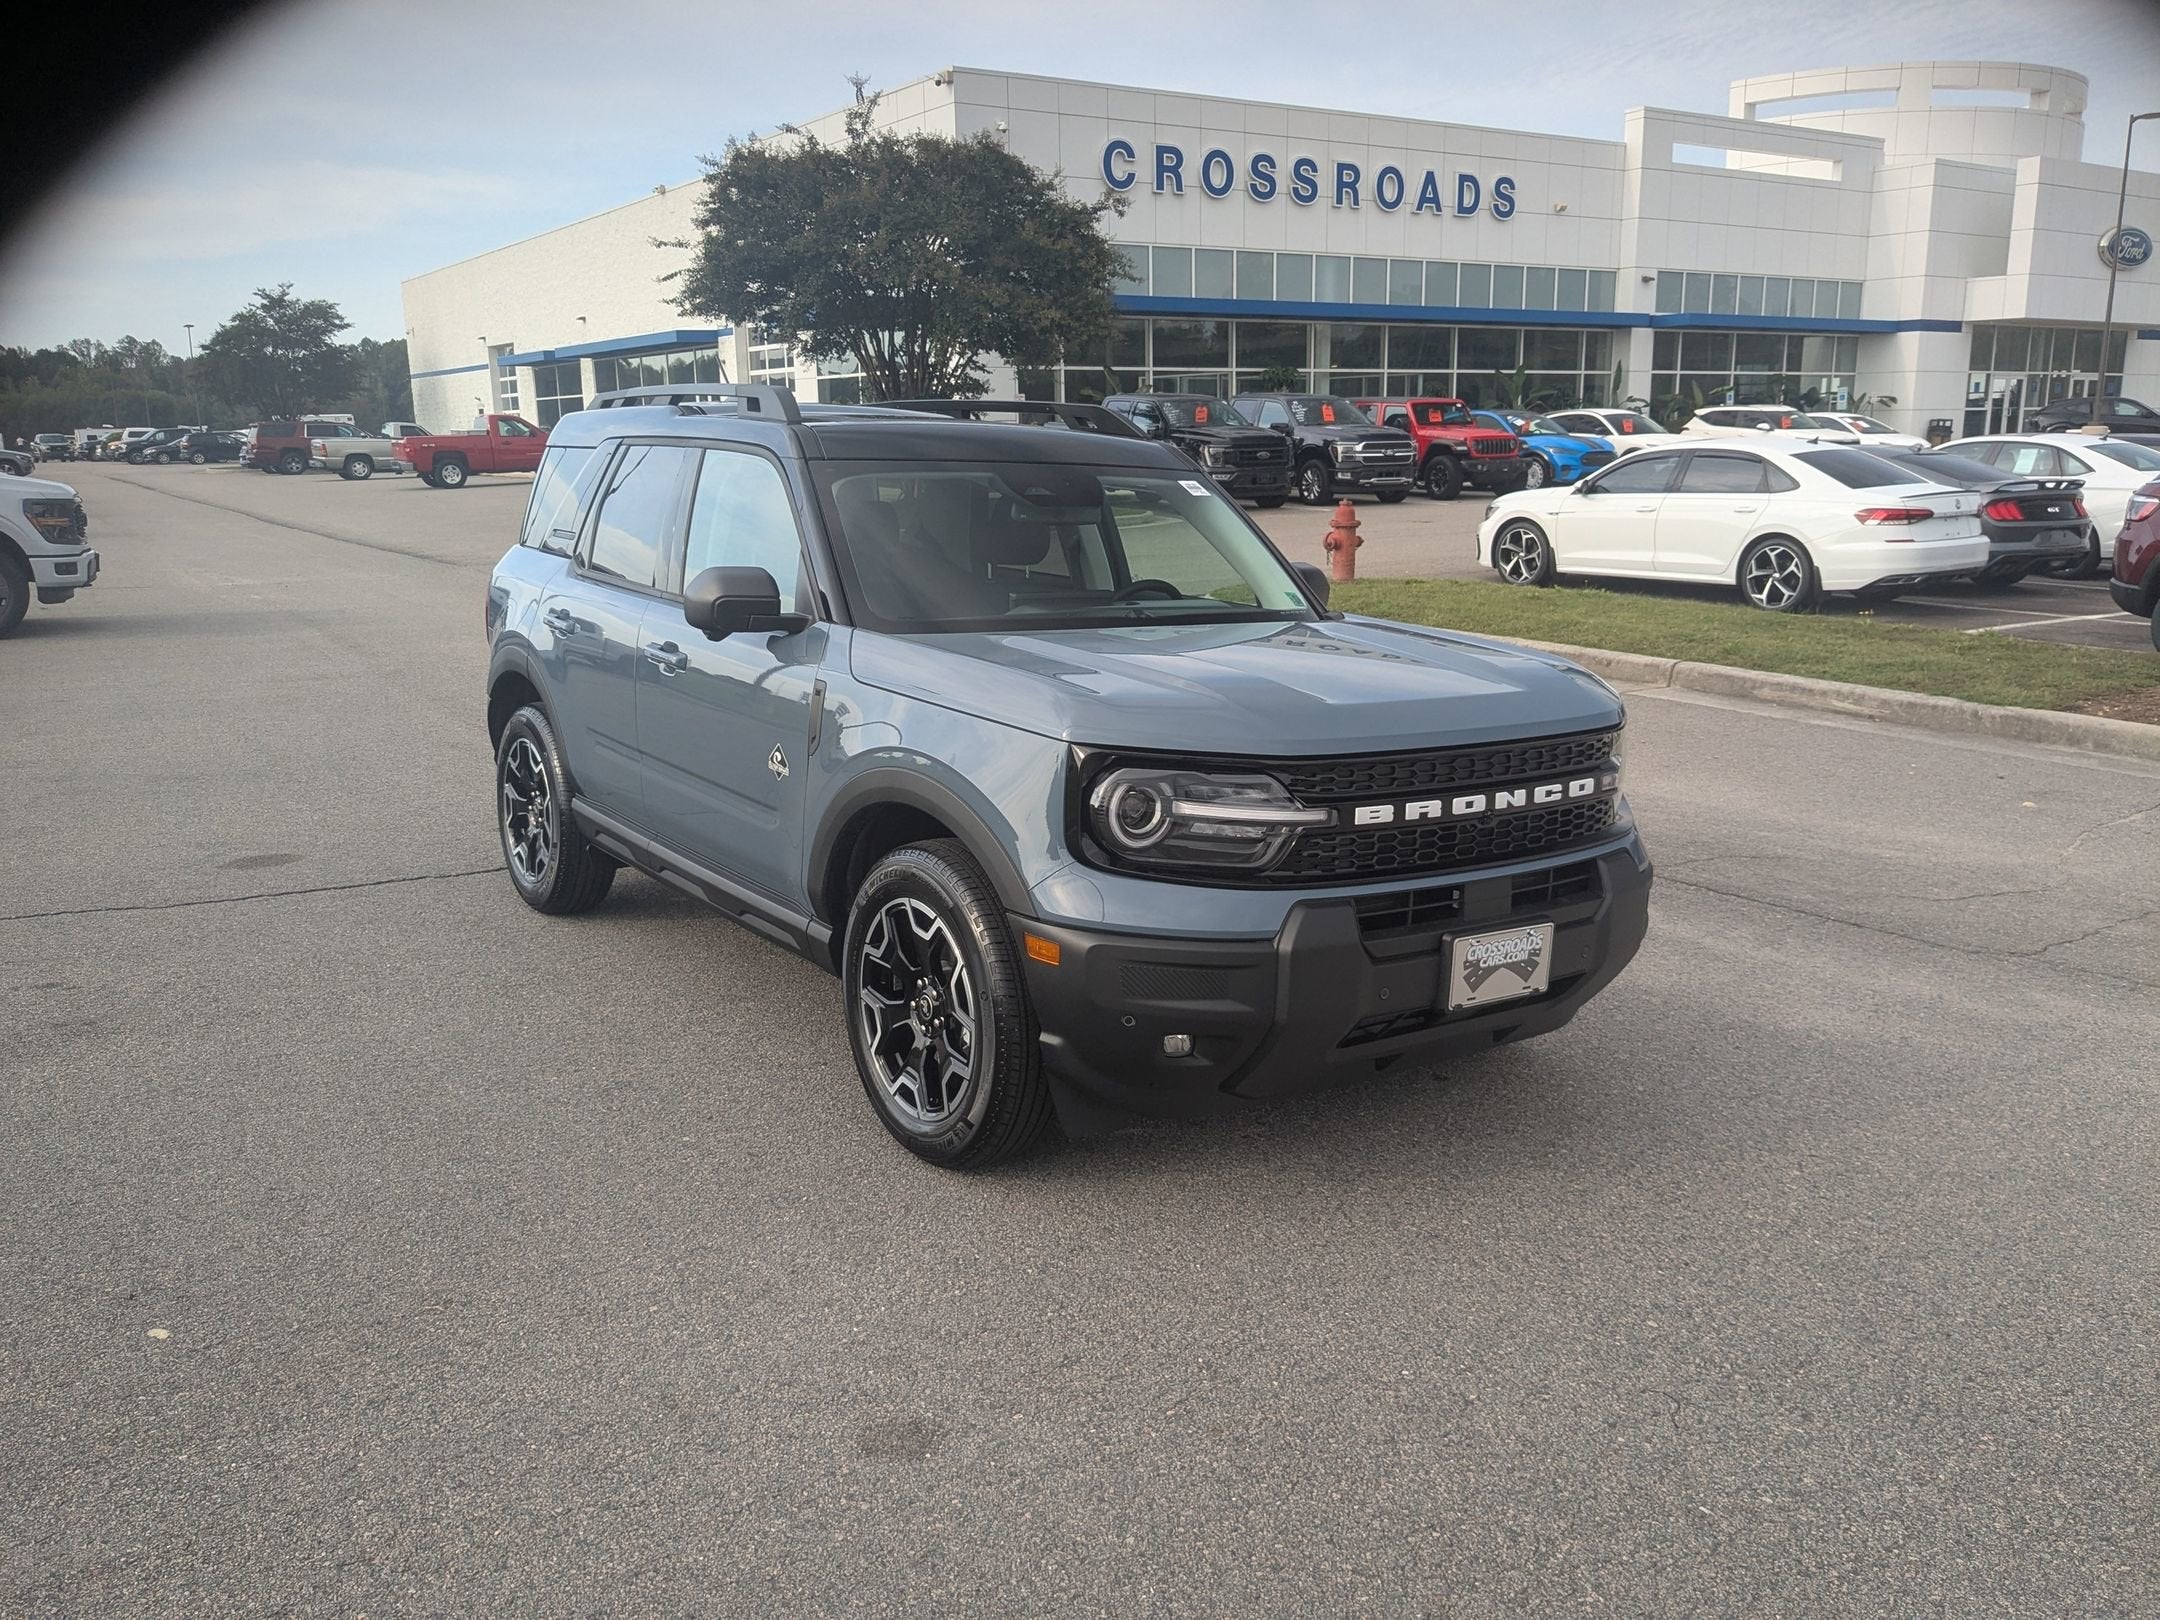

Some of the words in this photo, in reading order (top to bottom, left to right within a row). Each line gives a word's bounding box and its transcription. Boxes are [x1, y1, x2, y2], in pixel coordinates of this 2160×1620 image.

[1102, 138, 1517, 221] CROSSROADS
[2118, 235, 2146, 259] Ford
[1354, 778, 1595, 825] BRONCO
[1466, 935, 1543, 961] CROSSROADS
[1480, 950, 1529, 967] CARS.COM
